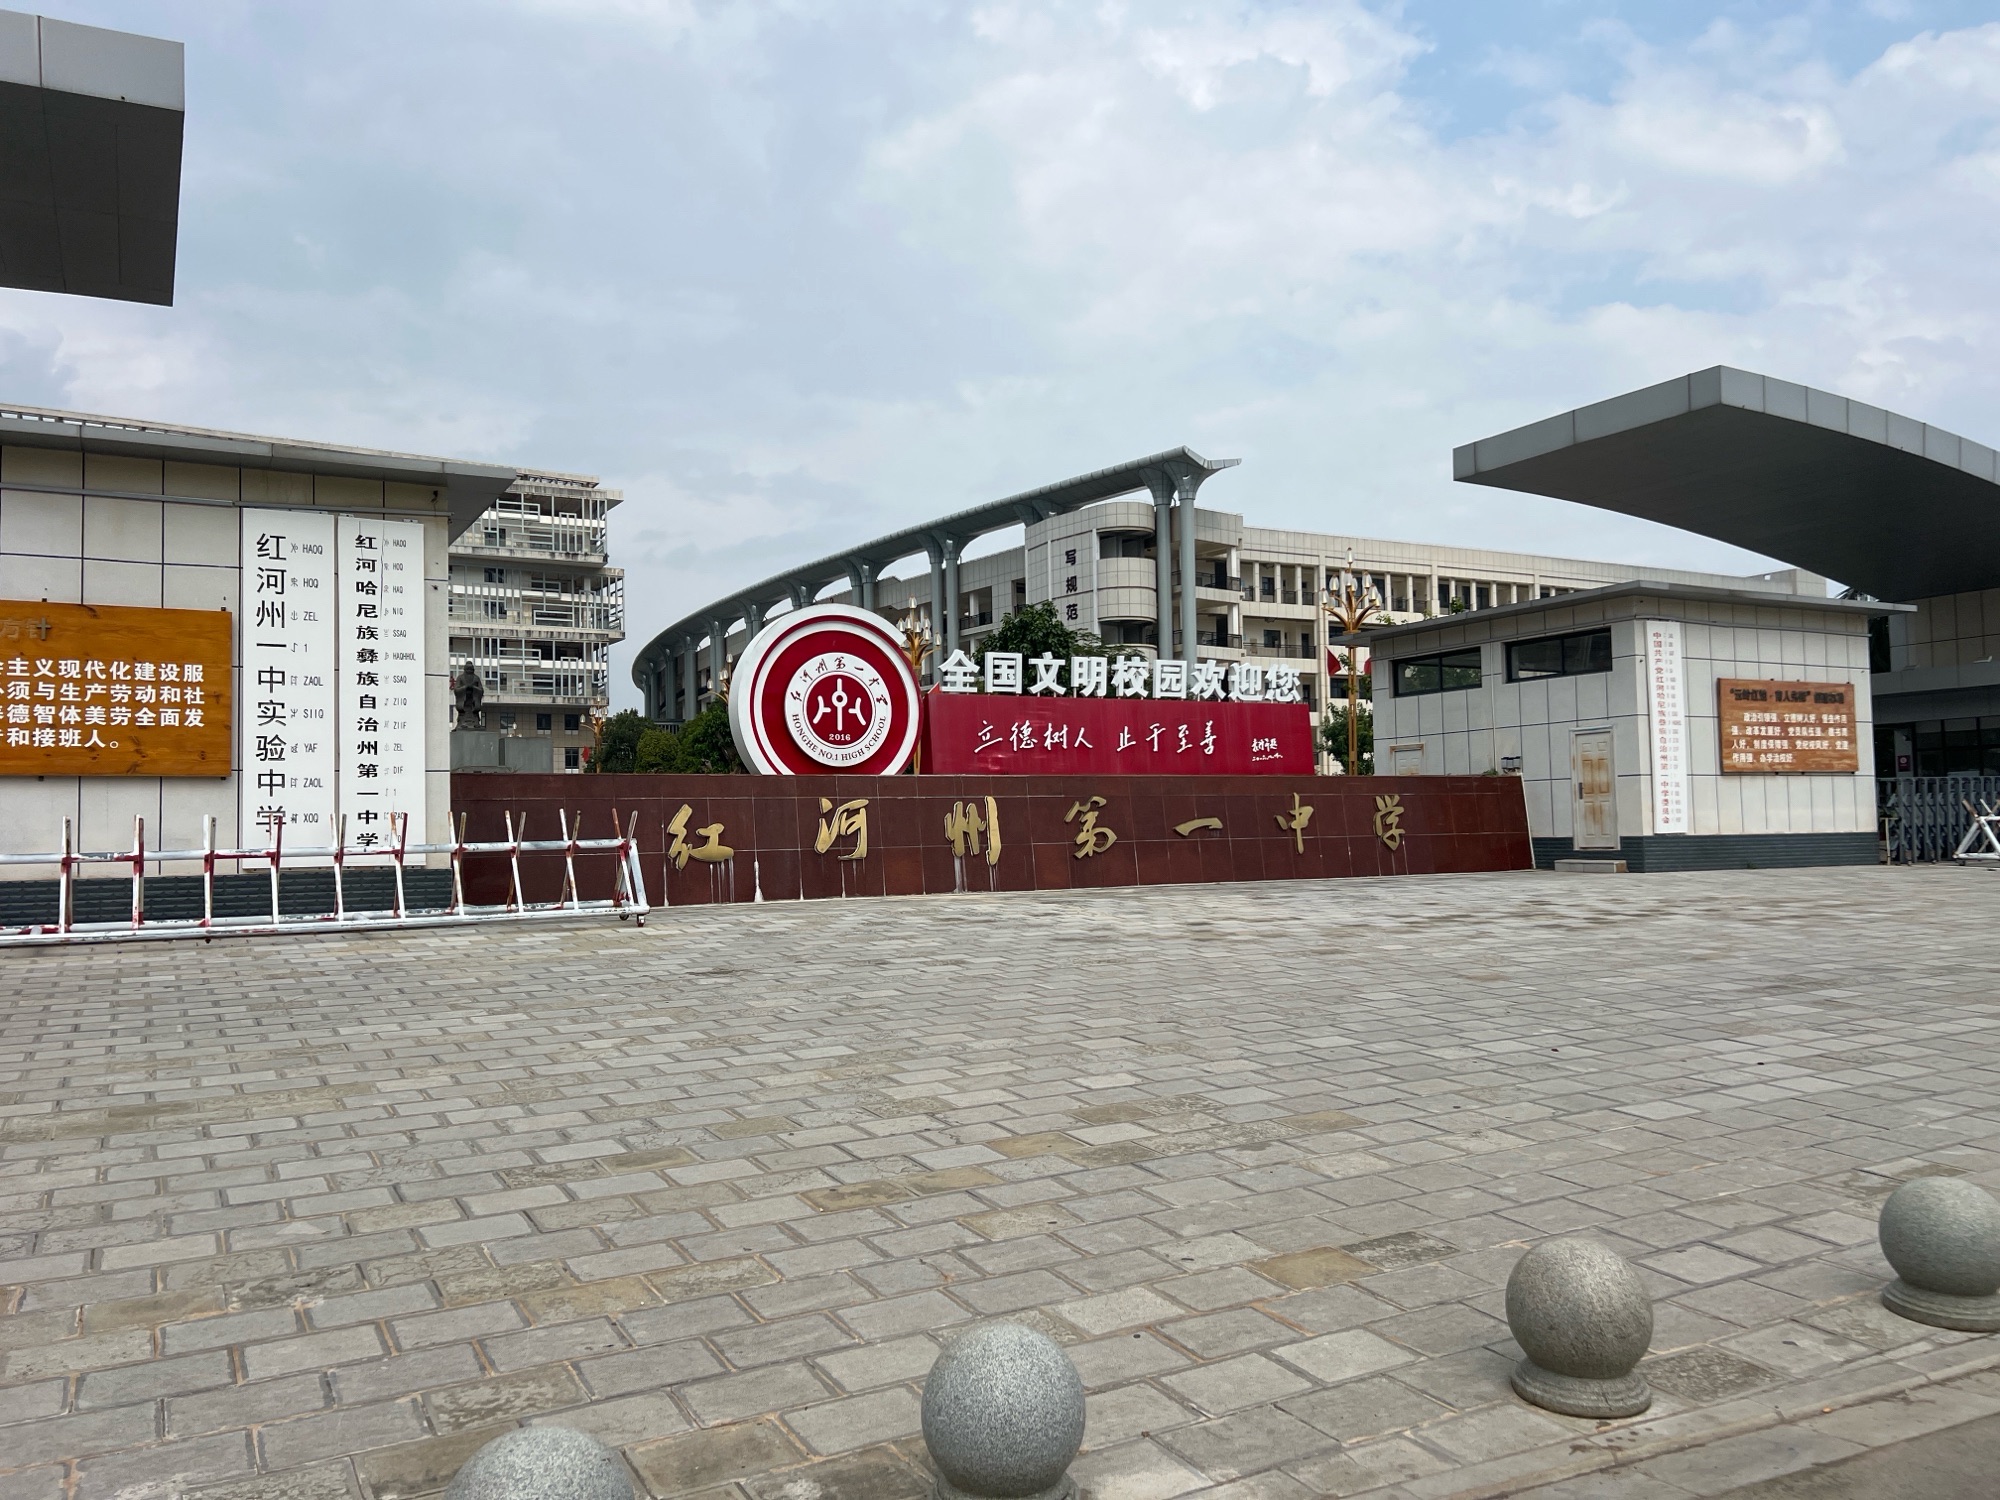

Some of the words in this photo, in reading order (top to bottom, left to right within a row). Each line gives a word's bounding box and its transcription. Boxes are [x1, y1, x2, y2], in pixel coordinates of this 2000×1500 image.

[303, 578, 319, 589] HOQ
[1065, 549, 1078, 621] 写规范
[303, 611, 319, 622] ZEL
[0, 658, 204, 682] 主义现代化建设服
[938, 649, 1301, 702] 全国文明校园欢迎您
[0, 681, 205, 705] 须与生产劳动和社
[255, 533, 287, 834] 红河州一中实验中学
[355, 535, 379, 848] 红河哈尼族彝族自治州第一中学
[0, 704, 205, 727] 德智体美劳全面发
[0, 727, 119, 749] 和接班人。
[303, 743, 318, 753] YAF
[393, 743, 404, 752] ZEL
[792, 714, 817, 752] HONGHE
[818, 749, 839, 761] NO.1
[841, 748, 865, 761] HIGH
[864, 716, 887, 751] SCHOOL
[828, 733, 851, 741] 2016
[974, 720, 1093, 753] 立德树人
[1116, 721, 1217, 754] 止于至善
[303, 812, 319, 824] XOQ
[668, 792, 1406, 871] 红河州第一中学
